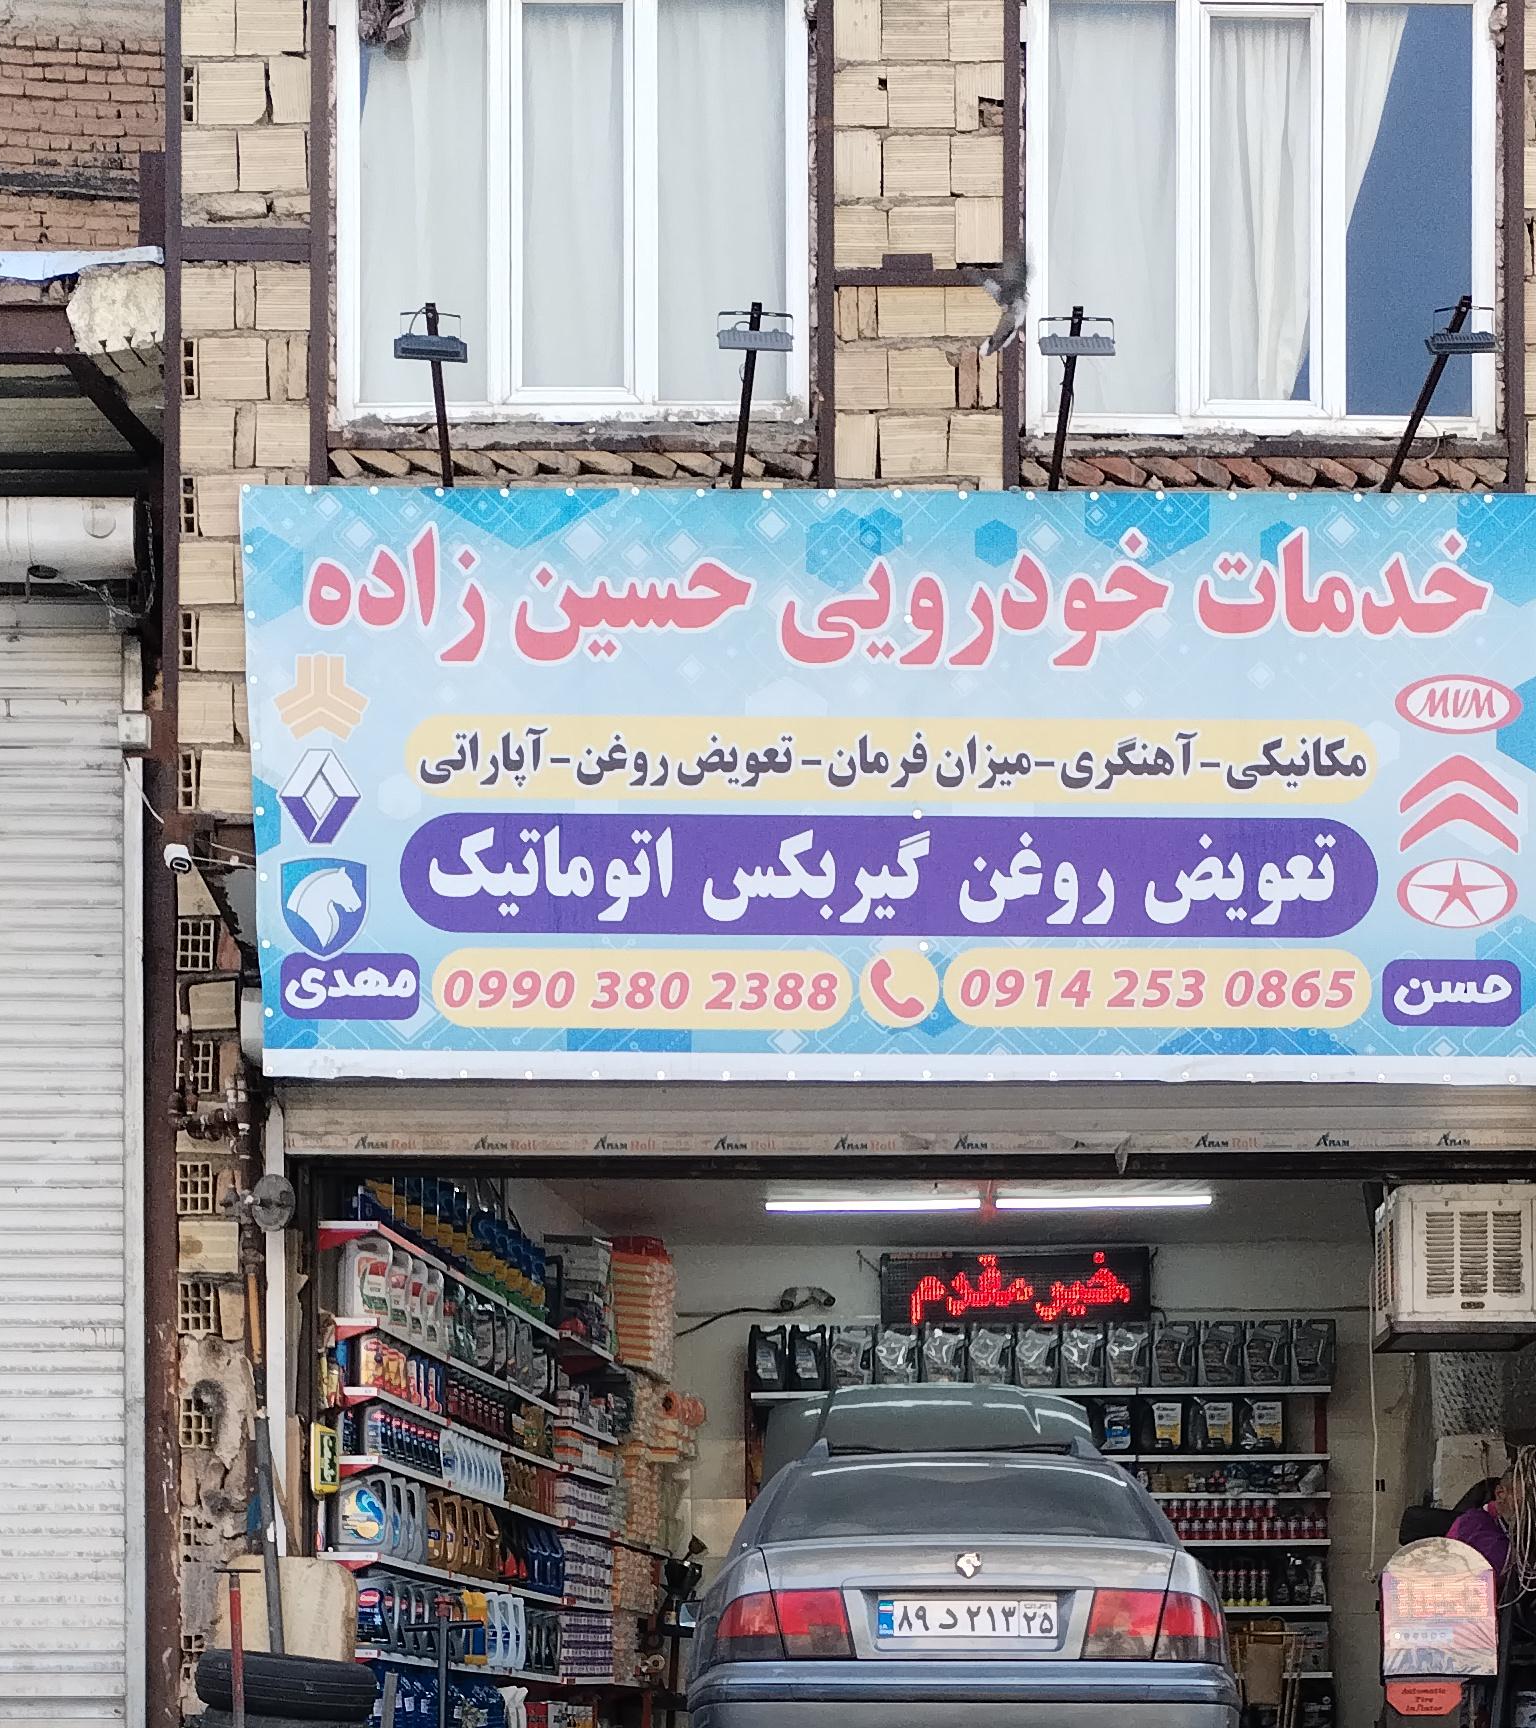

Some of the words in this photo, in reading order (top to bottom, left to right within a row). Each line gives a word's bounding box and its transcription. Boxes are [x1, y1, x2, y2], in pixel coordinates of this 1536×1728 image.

[307, 525, 486, 662] زاده
[513, 557, 753, 662] حسین
[780, 530, 1169, 666] خودرویی
[1199, 529, 1488, 636] خدمات
[1415, 686, 1497, 719] MVM
[419, 728, 548, 787] آپاراتی
[575, 734, 670, 787] روغن
[677, 735, 794, 787] تعویض
[827, 731, 929, 789] فرمان
[935, 734, 1032, 789] میزان
[1060, 732, 1199, 790] آهنگری
[1225, 736, 1368, 790] مکانیکی
[428, 825, 673, 923] اتوماتیک
[702, 829, 931, 925] گیربکس
[958, 831, 1116, 925] روغن
[1144, 832, 1337, 926] تعویض
[284, 965, 419, 1011] مهدی
[442, 969, 577, 1011] 0990
[590, 971, 692, 1011] 380
[704, 972, 840, 1012] 2388
[959, 968, 1093, 1009] 0914
[1106, 969, 1208, 1009] 253
[1224, 969, 1357, 1009] 0865
[1392, 973, 1515, 1016] حسن
[910, 1253, 1034, 1325] مقدم
[1034, 1251, 1131, 1322] خیر
